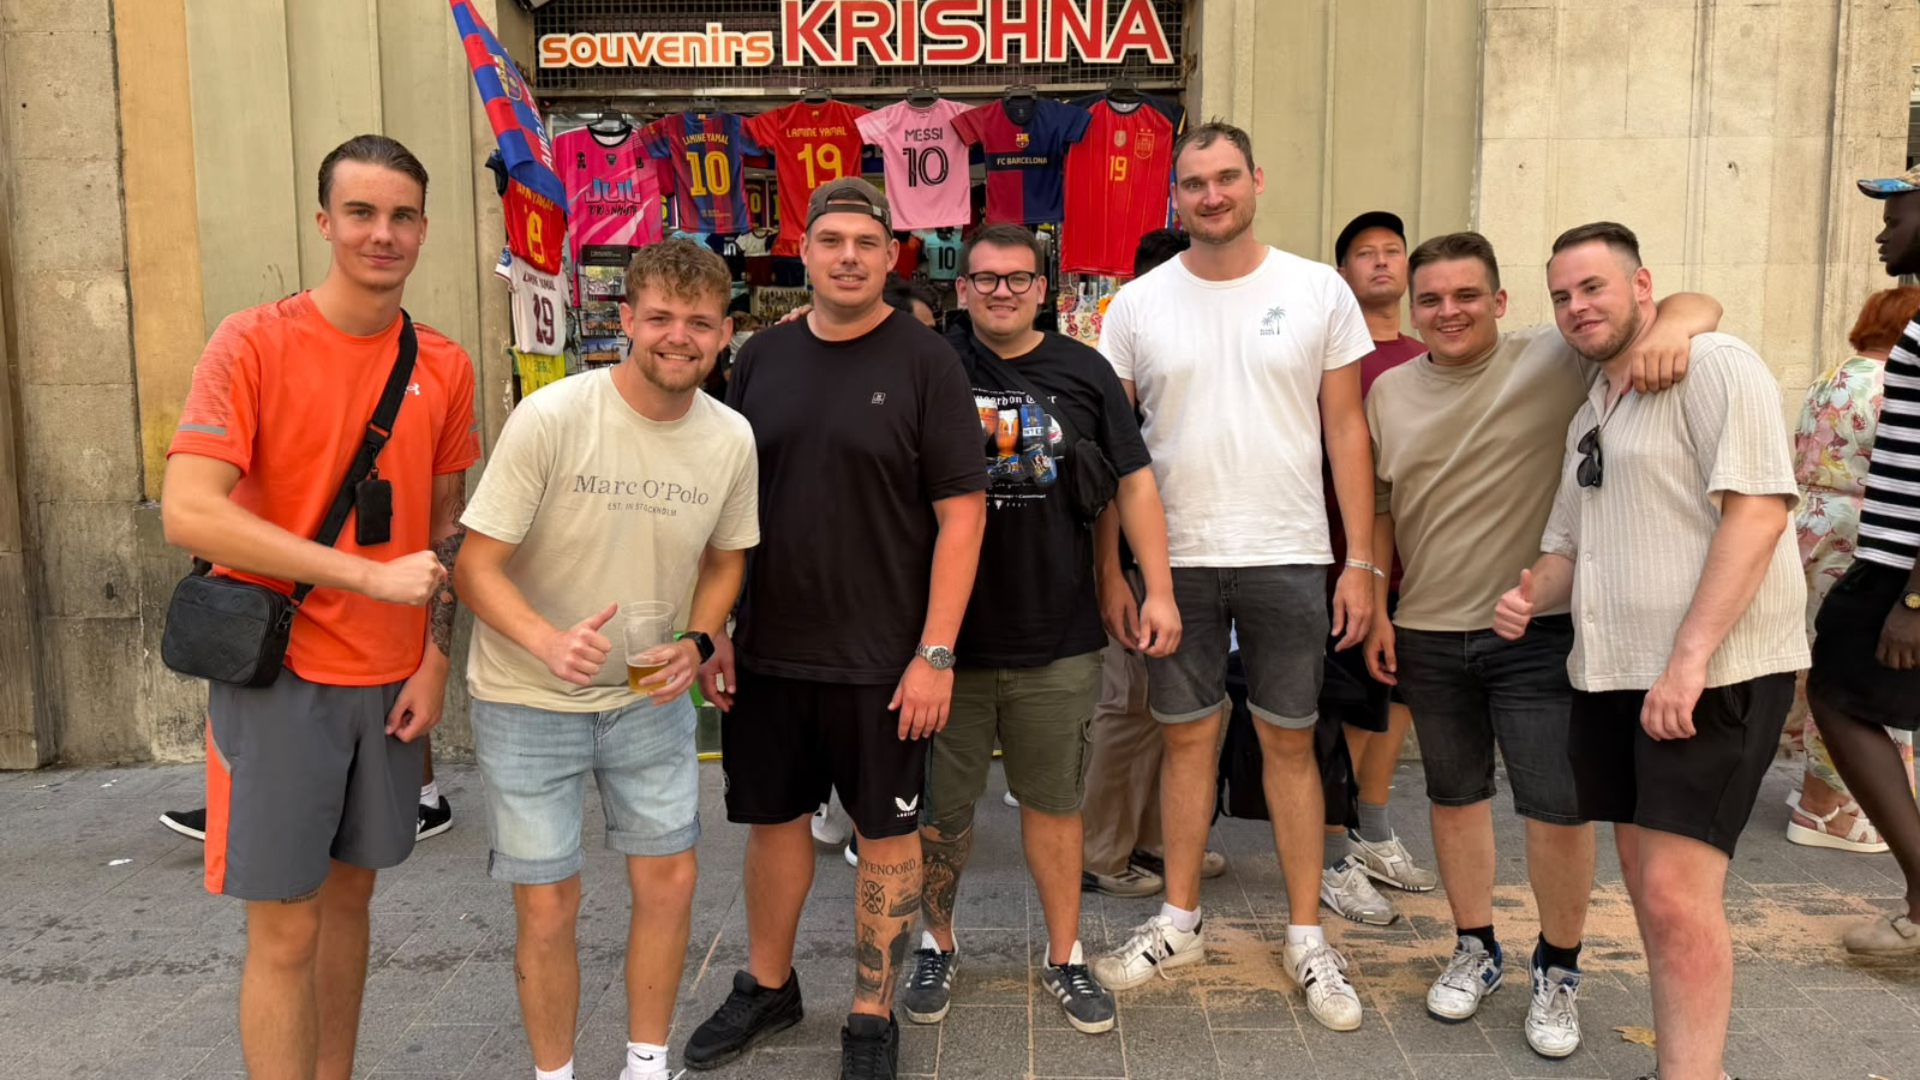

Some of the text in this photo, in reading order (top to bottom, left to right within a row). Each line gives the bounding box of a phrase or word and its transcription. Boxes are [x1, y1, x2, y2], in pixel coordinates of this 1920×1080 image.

[784, 0, 1171, 64] KRISHNA
[682, 132, 729, 146] LAMINE YAMAL
[786, 126, 848, 138] LAMINE YAMAL
[904, 127, 943, 141] MESSI
[686, 150, 731, 197] 10
[797, 143, 843, 189] 19
[903, 145, 949, 188] 10
[996, 156, 1048, 166] FC BARCELONA
[1109, 155, 1127, 181] 19
[938, 245, 957, 271] 10
[533, 292, 555, 347] 19
[573, 474, 709, 505] Marc O'Polo
[625, 502, 634, 510] IN
[635, 502, 677, 517] STOCKHOLM
